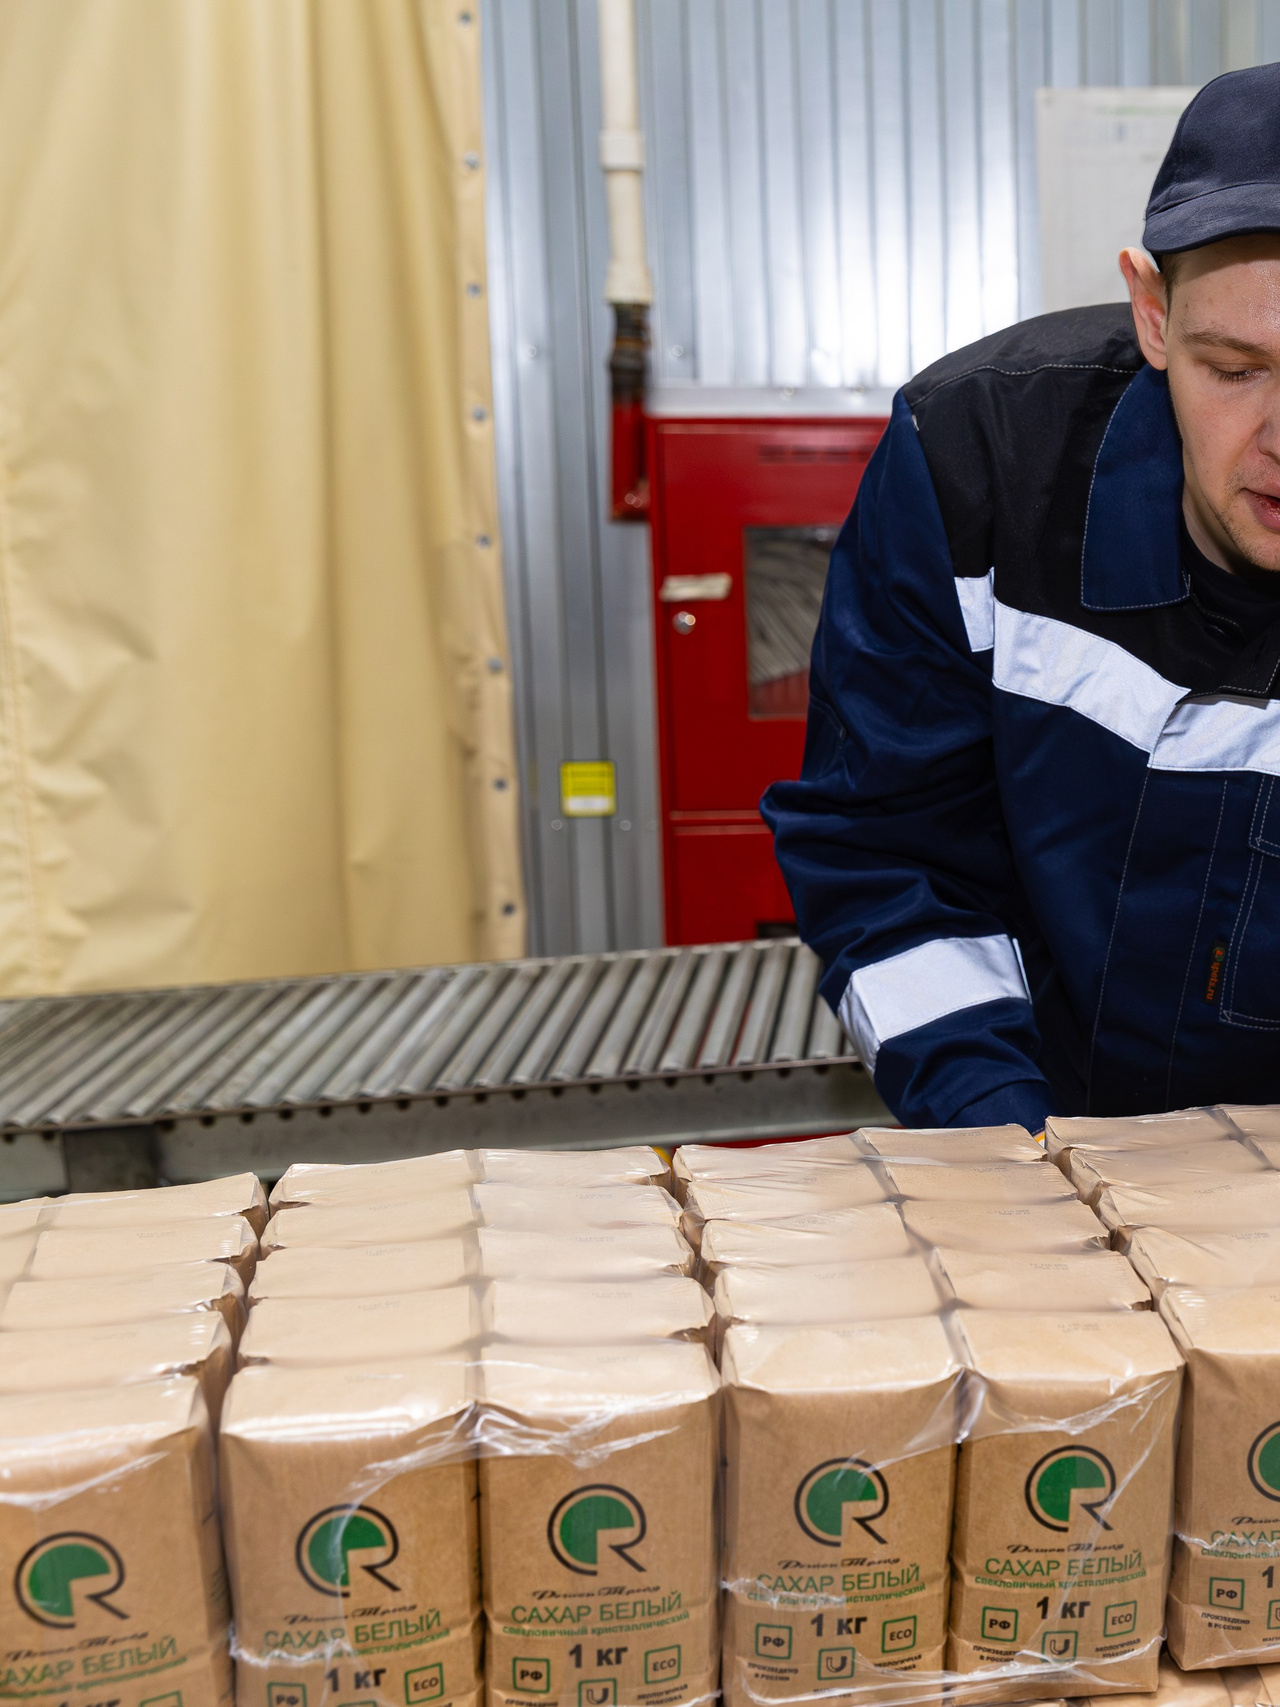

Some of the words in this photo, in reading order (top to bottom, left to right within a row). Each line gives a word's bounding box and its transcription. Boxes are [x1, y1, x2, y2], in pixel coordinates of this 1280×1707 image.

[985, 1557, 1060, 1577] САХАР
[1067, 1549, 1143, 1577] БЕЛЫЙ
[757, 1573, 834, 1593] САХАР
[842, 1562, 921, 1591] БЕЛЫЙ
[975, 1576, 1056, 1589] свекловичный
[1262, 1565, 1274, 1588] 1
[1216, 1588, 1238, 1600] РФ
[511, 1605, 592, 1624] САХАР
[600, 1590, 682, 1622] БЕЛЫЙ
[1036, 1596, 1049, 1620] 1
[264, 1628, 345, 1650] САХАР
[354, 1608, 441, 1644] БЕЛЫЙ
[591, 1610, 690, 1636] кристаллический
[811, 1613, 824, 1637] 1
[989, 1618, 1011, 1630] РФ
[762, 1636, 785, 1647] РФ
[0, 1660, 74, 1687] АХАР
[82, 1634, 178, 1676] БЕЛЫЙ
[569, 1644, 582, 1668] 1
[326, 1668, 339, 1692] 1
[520, 1670, 543, 1681] РФ
[275, 1694, 300, 1707] РФ
